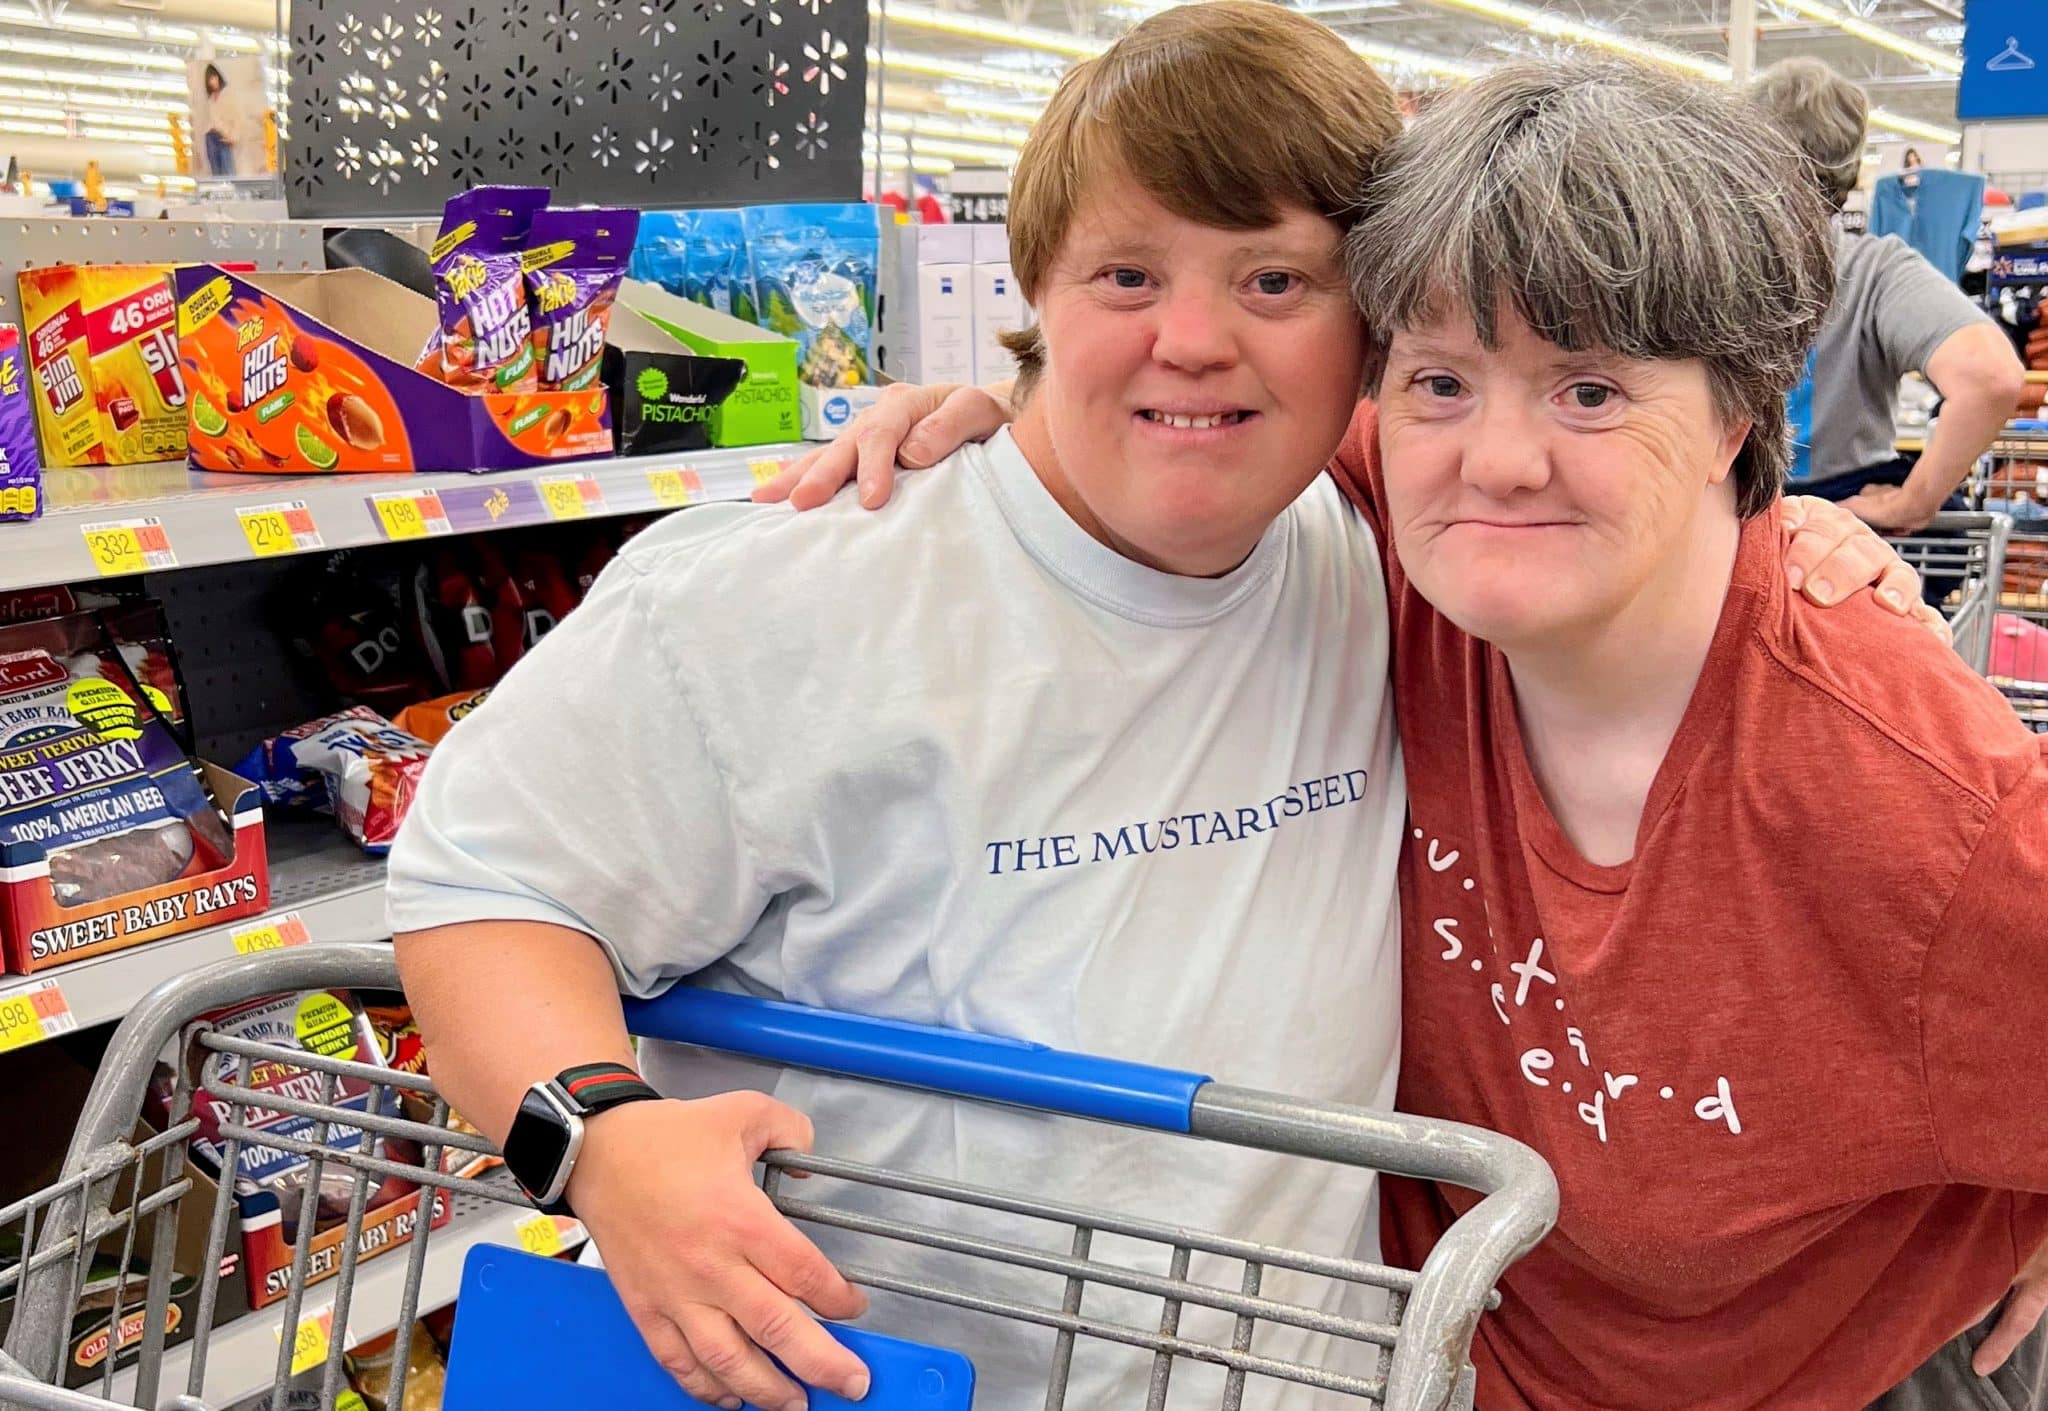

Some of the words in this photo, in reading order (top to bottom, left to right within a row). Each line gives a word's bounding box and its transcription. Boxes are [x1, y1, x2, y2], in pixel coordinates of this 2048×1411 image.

[523, 248, 551, 261] DOUBLE
[524, 255, 554, 269] CRUNCH
[189, 288, 216, 312] DOUBLE
[470, 276, 520, 336] HOT
[535, 276, 577, 316] Takis
[36, 312, 70, 342] ORIGINAL
[110, 303, 144, 335] 46
[192, 301, 219, 324] CRUNCH
[237, 315, 264, 352] Takis
[477, 304, 531, 370] NUTS
[552, 309, 588, 350] HO
[38, 336, 54, 358] 46
[244, 334, 279, 380] HOT
[546, 317, 604, 381] NUTS
[243, 356, 288, 408] NUTS
[735, 386, 792, 405] PISTACHIOS
[72, 686, 118, 699] PREMIUM
[80, 693, 122, 706] QUALITY
[7, 706, 41, 723] BABY
[55, 739, 145, 790] JERKY
[81, 787, 112, 802] PROTEIN
[11, 816, 60, 842] 100%
[59, 794, 136, 834] AMERICAN
[986, 834, 1080, 874] THE
[1282, 769, 1368, 817] SEED
[30, 911, 119, 960] SWEET
[123, 894, 188, 935] BABY
[194, 875, 257, 916] RAY'S
[219, 1009, 263, 1029] PREMIUM
[265, 999, 296, 1014] BRAND
[300, 1002, 337, 1021] PREMIUM
[305, 1011, 339, 1029] QUALITY
[306, 1024, 352, 1047] TENDER
[316, 1035, 350, 1055] JERKY
[342, 1221, 391, 1260] ABY
[85, 1337, 108, 1358] OLD
